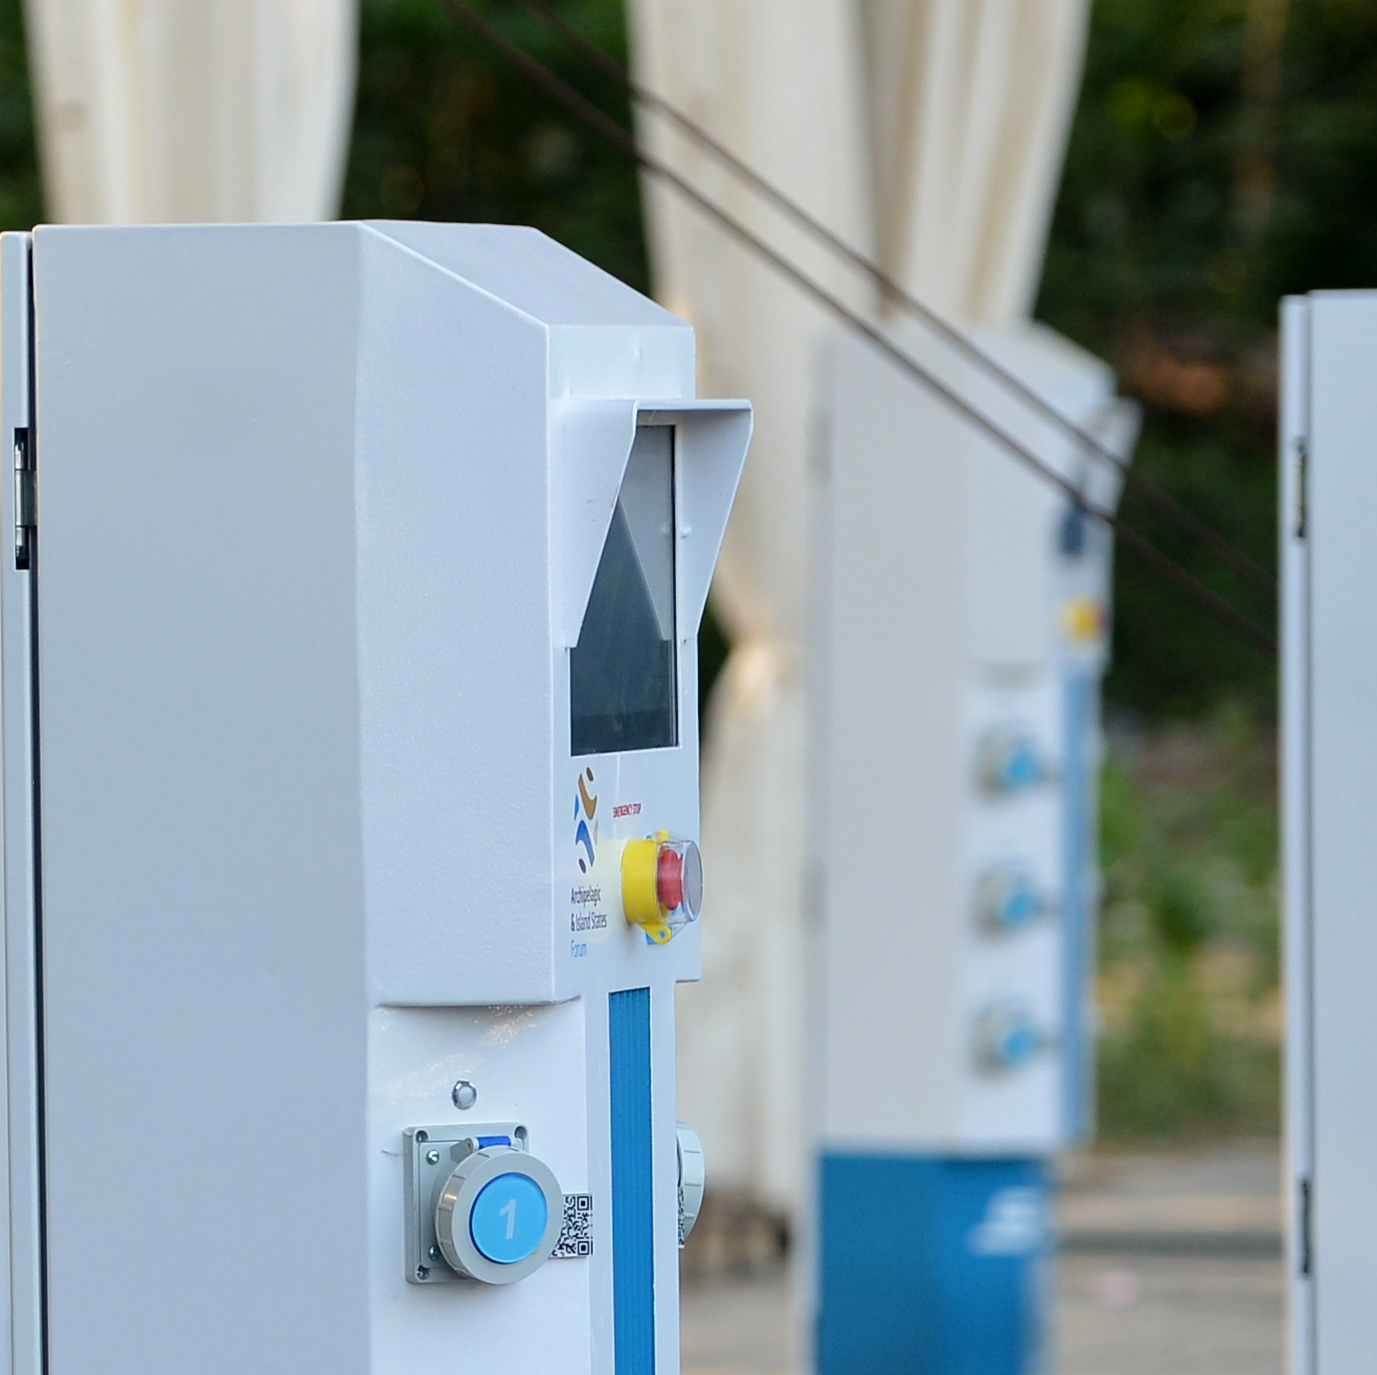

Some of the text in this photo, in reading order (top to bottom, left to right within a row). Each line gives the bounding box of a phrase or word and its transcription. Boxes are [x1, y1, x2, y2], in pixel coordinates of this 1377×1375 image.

[571, 884, 601, 908] Archipelagic
[576, 910, 591, 931] Island
[591, 911, 608, 930] States
[499, 1198, 518, 1240] 1
